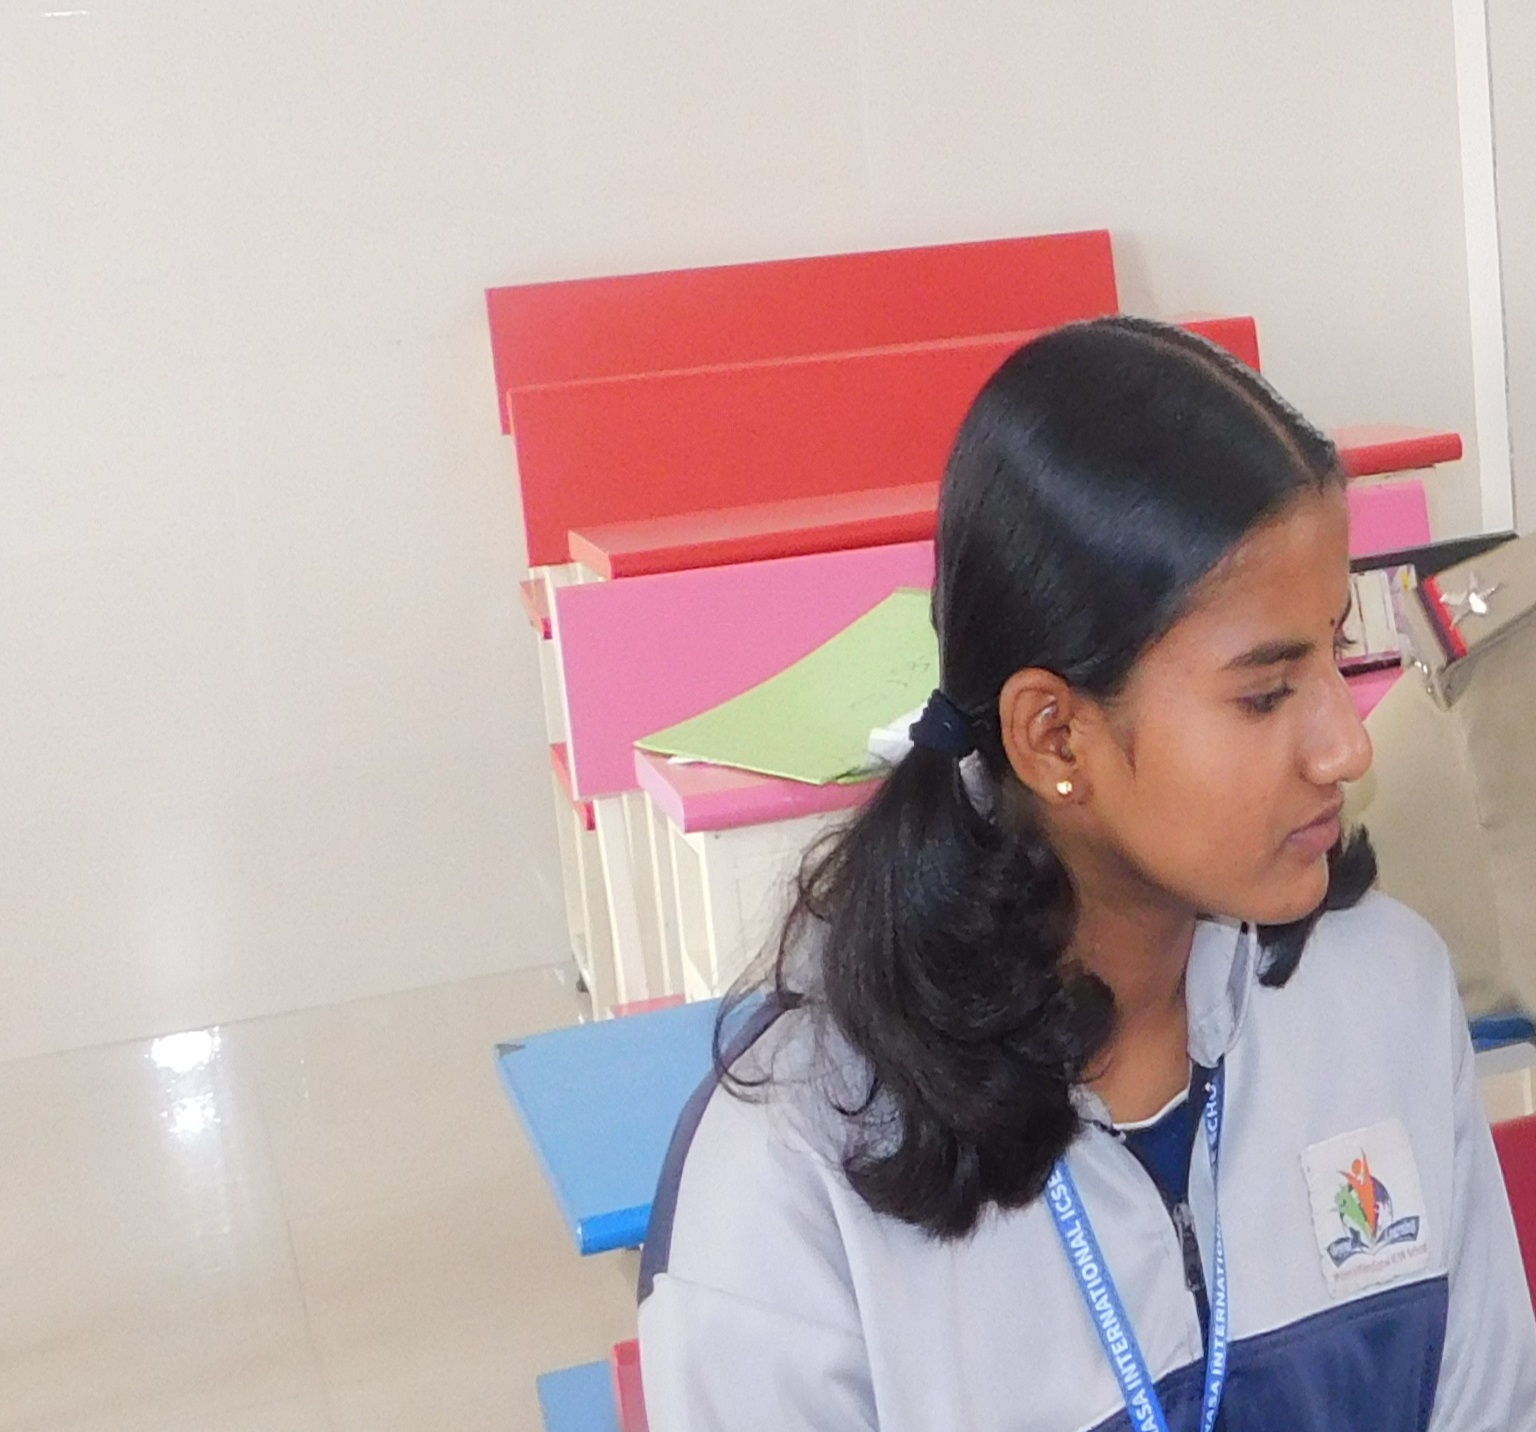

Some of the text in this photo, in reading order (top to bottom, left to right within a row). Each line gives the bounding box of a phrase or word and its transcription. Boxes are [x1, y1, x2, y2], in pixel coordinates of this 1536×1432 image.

[1047, 1170, 1075, 1221] ICSE
[1067, 1220, 1142, 1391] INTERNATIONAL
[1212, 1223, 1227, 1376] INTERNATION
